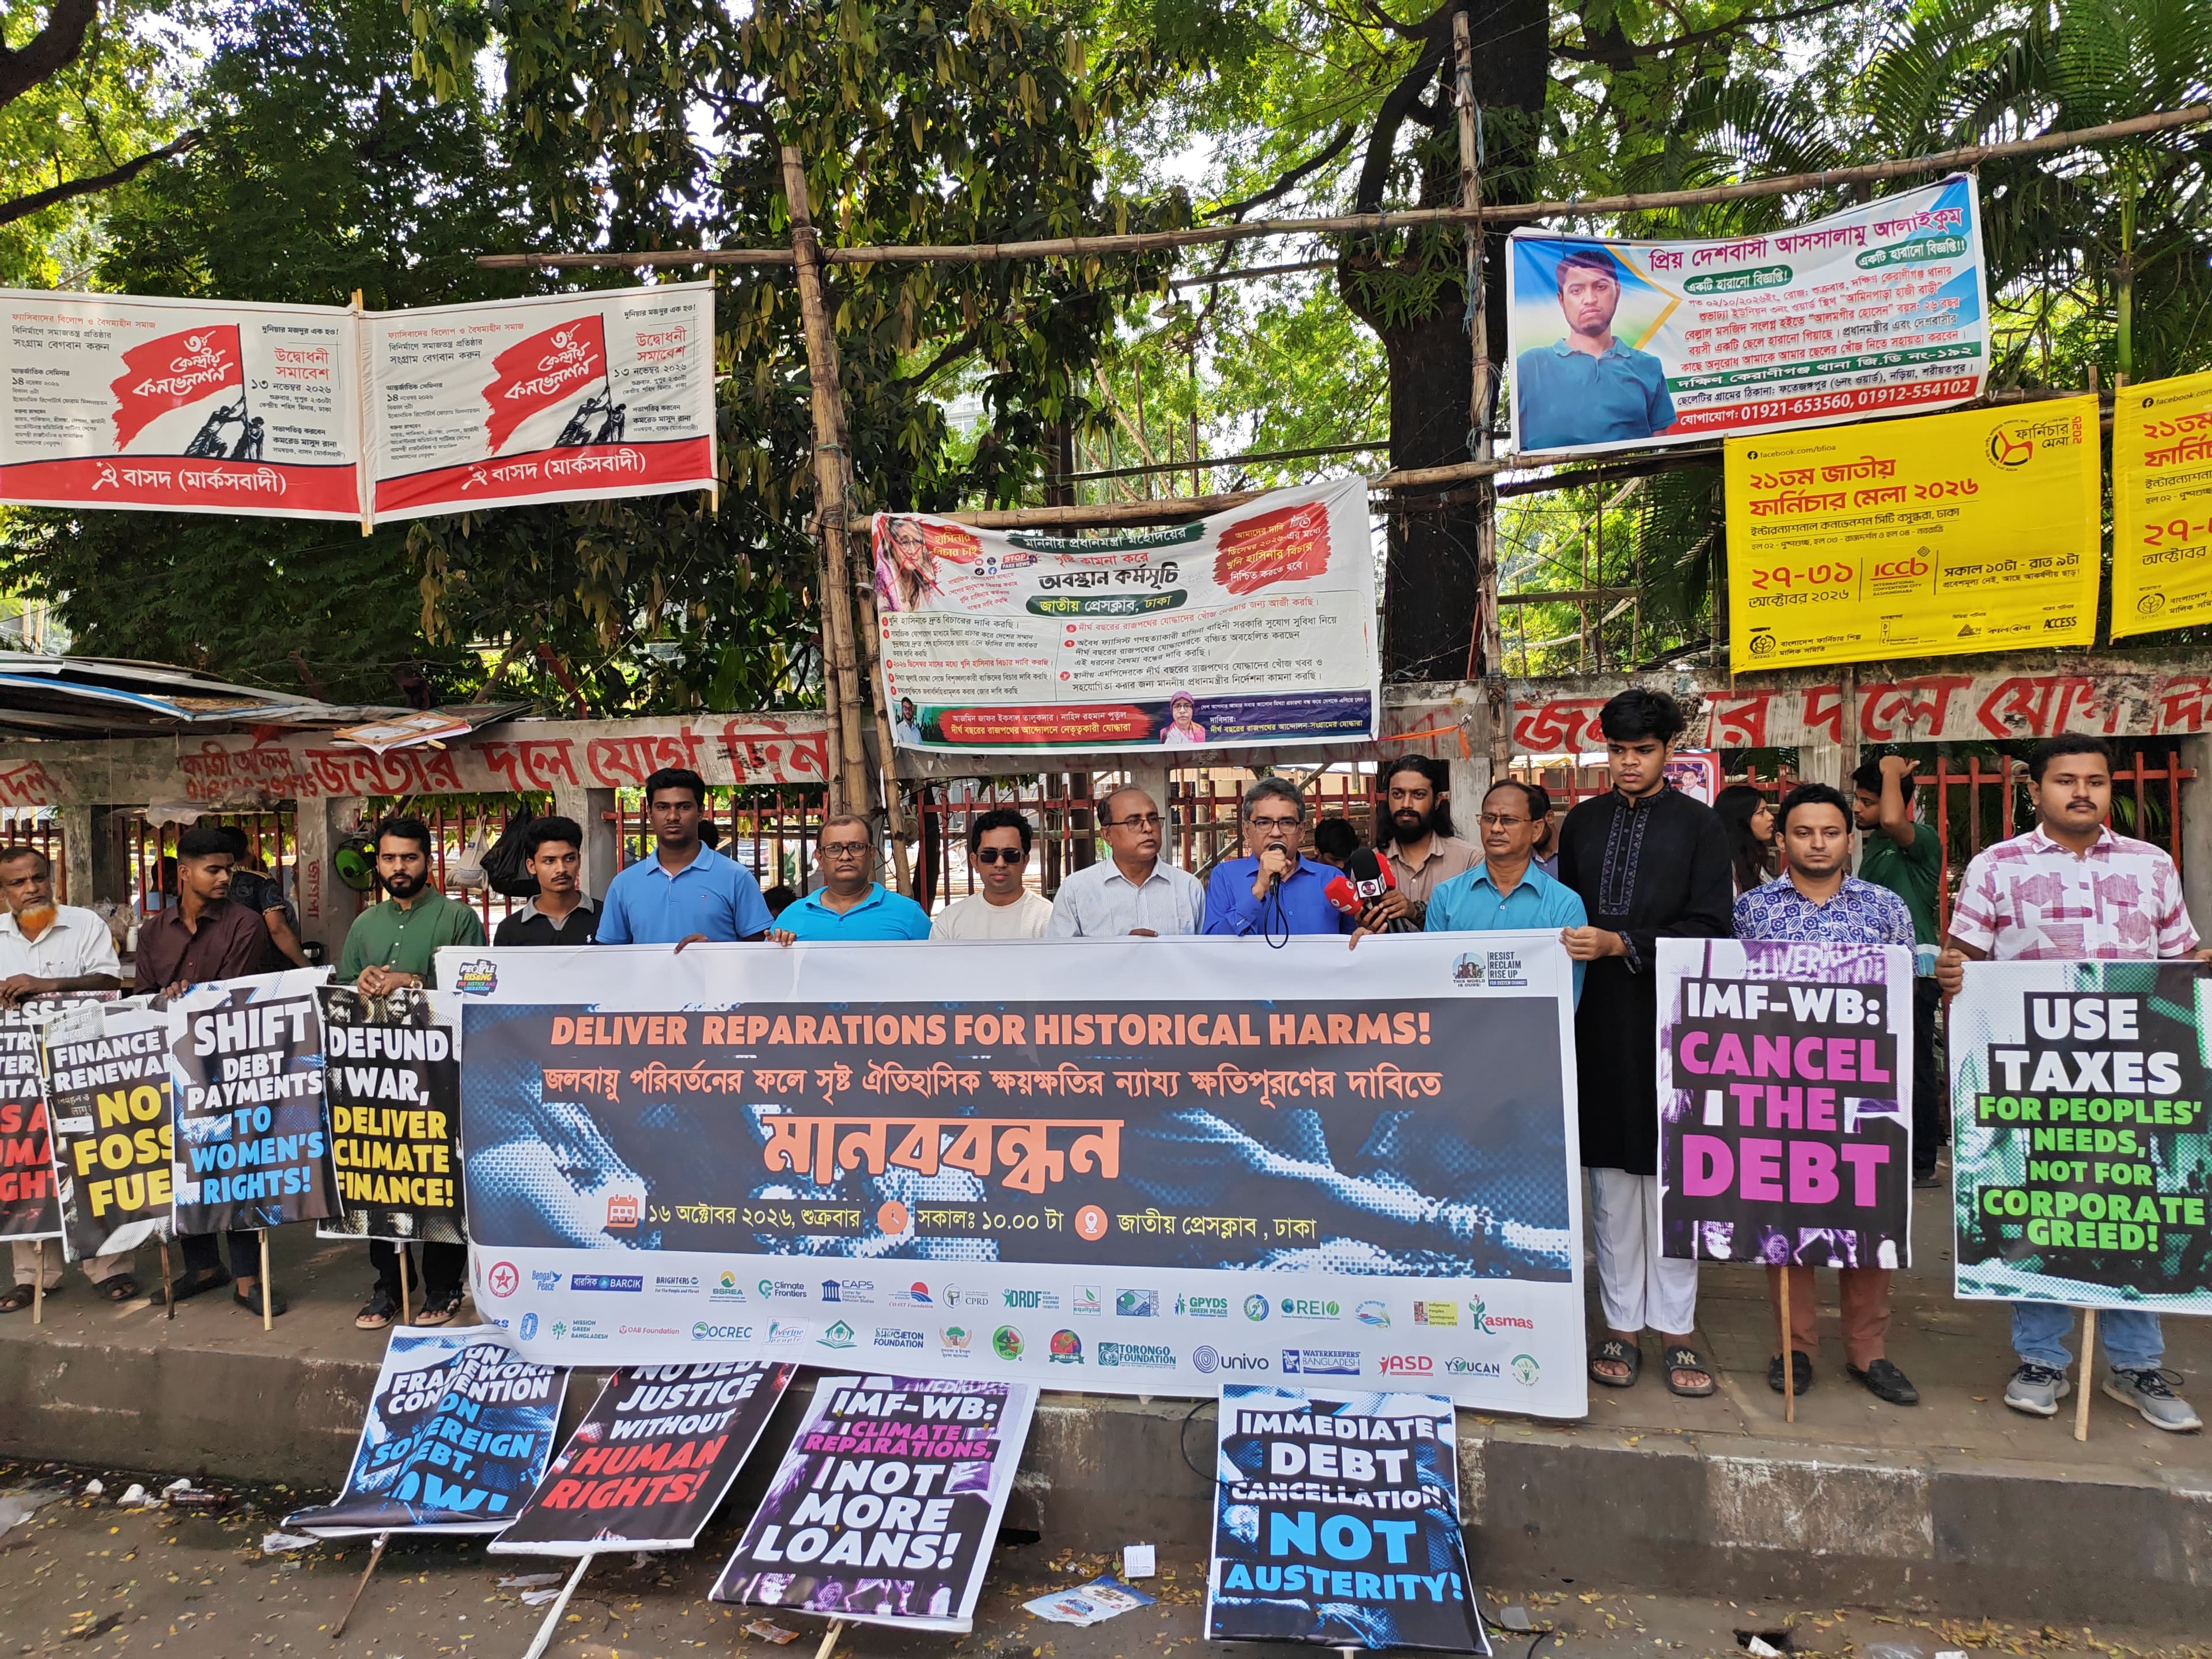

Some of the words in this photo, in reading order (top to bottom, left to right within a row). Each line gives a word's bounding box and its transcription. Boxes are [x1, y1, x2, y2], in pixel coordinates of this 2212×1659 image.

[1649, 248, 1683, 271] প্রিয়
[1692, 236, 1768, 267] দেশবাসী
[1775, 225, 1868, 254] আসসালামু
[1874, 207, 1963, 237] আলাইকুম
[13, 338, 43, 349] সংগ্রাম
[48, 340, 81, 350] বেগবান
[86, 343, 109, 351] করুন
[274, 347, 329, 364] উদ্বোধনী
[251, 379, 268, 389] ১৩
[272, 383, 301, 392] নভেম্বর
[306, 384, 331, 393] ২০২৬
[275, 367, 329, 381] সমাবেশ
[1677, 375, 1723, 389] দক্ষিণ
[1816, 360, 1850, 372] থানা
[1680, 410, 1739, 426] যোগাযোগ:
[1741, 395, 1855, 421] 01921-653560,
[1858, 379, 1969, 406] 01912-554102
[492, 462, 538, 482] বাসদ
[544, 452, 646, 480] (মার্কসবাদী)
[1760, 445, 1836, 459] facebook.com/bfioa
[122, 468, 172, 488] বাসদ
[178, 466, 287, 496] (মার্কসবাদী)
[1749, 468, 1815, 490] ২১তম
[1821, 455, 1896, 483] জাতীয়
[1749, 489, 1846, 516] ফার্নিচার
[1854, 485, 1907, 509] মেলা
[1914, 478, 1979, 501] ২০২৬
[1078, 554, 1117, 566] কামনা
[1121, 552, 1149, 564] করে
[1944, 565, 1983, 577] সকাল
[1986, 559, 2017, 573] ১০টা
[2029, 558, 2052, 569] রাত
[2056, 553, 2080, 566] ৯টা
[1038, 570, 1109, 589] অবস্থান
[1113, 561, 1180, 590] কর্মসূচি
[1752, 562, 1853, 590] ২৭-৩১
[1040, 597, 1081, 612] জাতীয়
[1145, 595, 1172, 608] ঢাকা
[1748, 592, 1808, 608] অক্টোবর
[1812, 589, 1849, 601] ২০২৬
[2043, 616, 2077, 629] ACCESS
[1490, 952, 1515, 960] RESIST
[1490, 961, 1521, 969] RECLAIM
[1490, 970, 1506, 978] RISE
[1508, 970, 1518, 978] UP
[1687, 982, 1881, 1025] IMF-WB:
[194, 1001, 312, 1057] SHIFT
[550, 1016, 688, 1046] DELIVER
[702, 1014, 947, 1046] REPARATIONS
[954, 1014, 1025, 1046] FOR
[1035, 1014, 1260, 1046] HISTORICAL
[1269, 1012, 1430, 1046] HARMS!
[2032, 997, 2139, 1041] USE
[54, 1032, 161, 1068] FINANCE
[330, 1026, 449, 1062] DEFUND
[1680, 1031, 1890, 1083] CANCEL
[222, 1051, 284, 1082] DEBT
[1995, 1051, 2182, 1095] TAXES
[188, 1070, 323, 1111] PAYMENTS
[345, 1067, 430, 1106] WAR,
[543, 1066, 620, 1104] জলবায়ু
[630, 1059, 744, 1097] পরিবর্তনের
[753, 1066, 806, 1096] ফলে
[816, 1063, 854, 1108] সৃষ্ট
[861, 1061, 980, 1097] ঐতিহাসিক
[988, 1063, 1105, 1099] ক্ষয়ক্ষতির
[1113, 1067, 1182, 1099] ন্যায্য
[1188, 1064, 1335, 1110] ক্ষতিপূরণের
[1346, 1062, 1444, 1099] দাবিতে
[234, 1106, 272, 1134] TO
[1729, 1083, 1836, 1132] THE
[1979, 1096, 2046, 1121] FOR
[2050, 1097, 2201, 1126] PEOPLES'
[334, 1107, 448, 1139] DELIVER
[190, 1131, 324, 1173] WOMEN'S
[334, 1138, 449, 1173] CLIMATE
[762, 1113, 1125, 1195] মানববন্ধন
[2034, 1127, 2146, 1158] NEEDS,
[203, 1166, 311, 1205] RIGHTS!
[1682, 1135, 1889, 1208] DEBT
[2029, 1160, 2088, 1183] NOT
[2094, 1161, 2153, 1186] FOR
[338, 1172, 454, 1208] FINANCE!
[649, 1204, 671, 1224] ১৬
[676, 1202, 737, 1227] অক্টোবর
[741, 1208, 796, 1230] ২০২৬,
[801, 1206, 861, 1233] শুক্রবার
[1044, 1207, 1064, 1234] টা
[1983, 1188, 2205, 1225] CORPORATE
[1118, 1209, 1175, 1236] জাতীয়
[1183, 1213, 1257, 1240] প্রেসক্লাব
[1274, 1211, 1316, 1239] ঢাকা
[2027, 1217, 2159, 1252] GREED!
[532, 1270, 552, 1282] Bengal
[537, 1280, 555, 1291] Peace
[574, 1278, 598, 1288] বারসিক
[610, 1278, 641, 1289] BARCIK
[656, 1276, 690, 1285] BRIGHTERS
[774, 1281, 805, 1290] Climate
[842, 1280, 874, 1289] CAPS
[774, 1289, 807, 1298] Frontiers
[965, 1297, 989, 1305] CPRD
[1189, 1297, 1228, 1309] GPYDS
[643, 1327, 680, 1335] Foundation
[708, 1325, 753, 1338] OCREC
[1474, 1313, 1534, 1335] Kasmas
[465, 1346, 505, 1364] UN
[874, 1339, 924, 1349] FOUNDATION
[1119, 1344, 1171, 1356] TORONGO
[1119, 1354, 1176, 1365] FOUNDATION
[1221, 1353, 1270, 1370] univo
[1302, 1358, 1360, 1367] BANGLADESH
[1389, 1355, 1433, 1370] ASD
[616, 1373, 764, 1411] JUSTICE
[832, 1390, 998, 1421] IMF-WB:
[437, 1392, 481, 1423] ON
[609, 1408, 737, 1440] WITHOUT
[851, 1421, 962, 1441] CLIMATE
[1241, 1412, 1434, 1441] IMMEDIATE
[570, 1435, 729, 1475] HUMAN
[804, 1434, 994, 1459] REPARATIONS,
[830, 1459, 946, 1496] NOT
[1271, 1442, 1409, 1483] DEBT
[541, 1470, 711, 1509] RIGHTS!
[789, 1493, 955, 1532] MORE
[752, 1525, 962, 1570] LOANS!
[1270, 1511, 1416, 1565] NOT
[1225, 1563, 1463, 1603] AUSTERITY!
